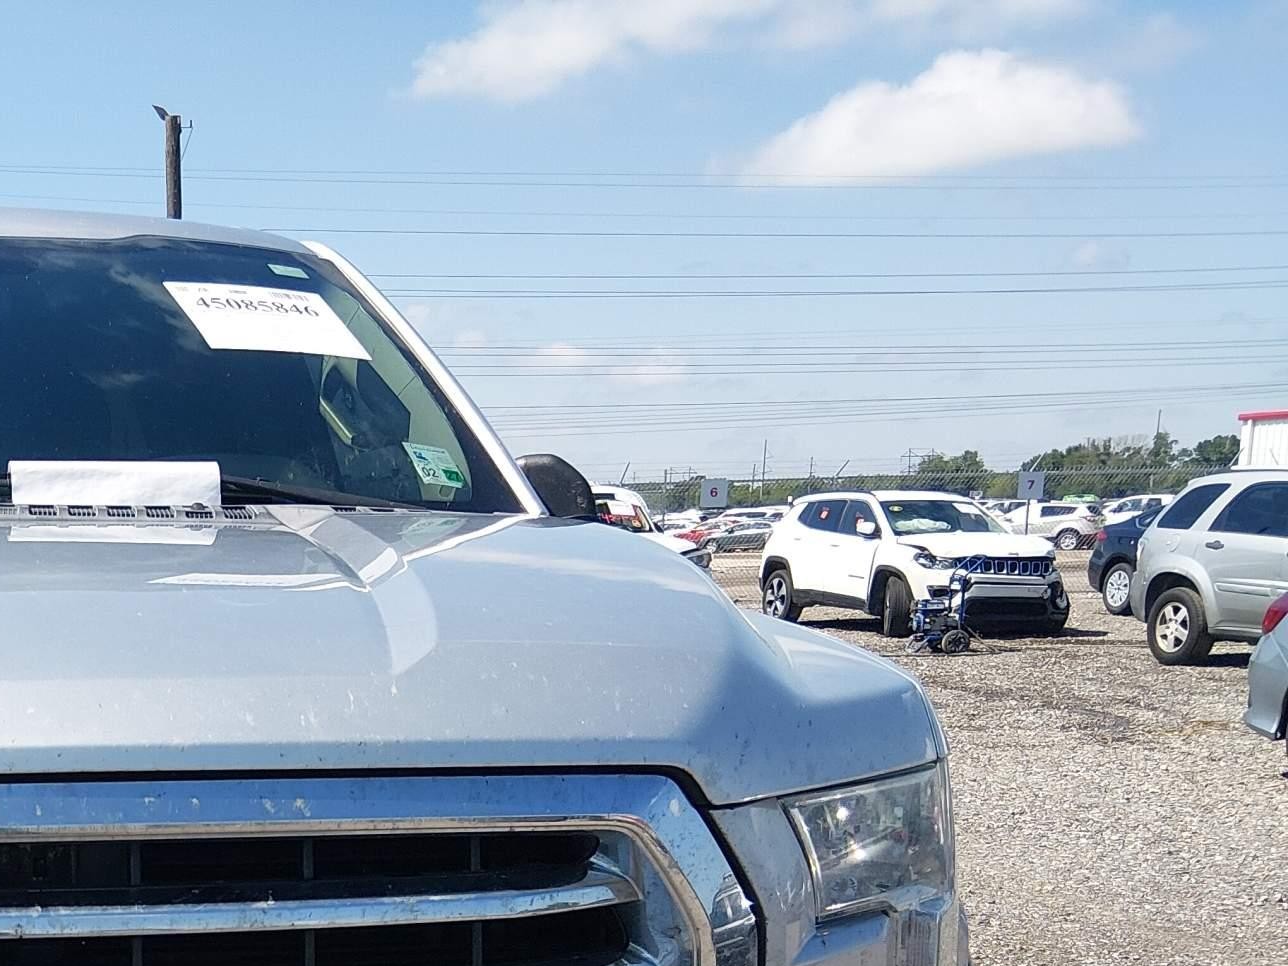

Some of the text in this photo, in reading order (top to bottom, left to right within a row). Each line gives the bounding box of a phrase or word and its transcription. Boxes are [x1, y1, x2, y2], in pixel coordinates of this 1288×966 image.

[196, 297, 320, 318] 45085846
[1026, 479, 1036, 490] 7
[709, 487, 719, 498] 6
